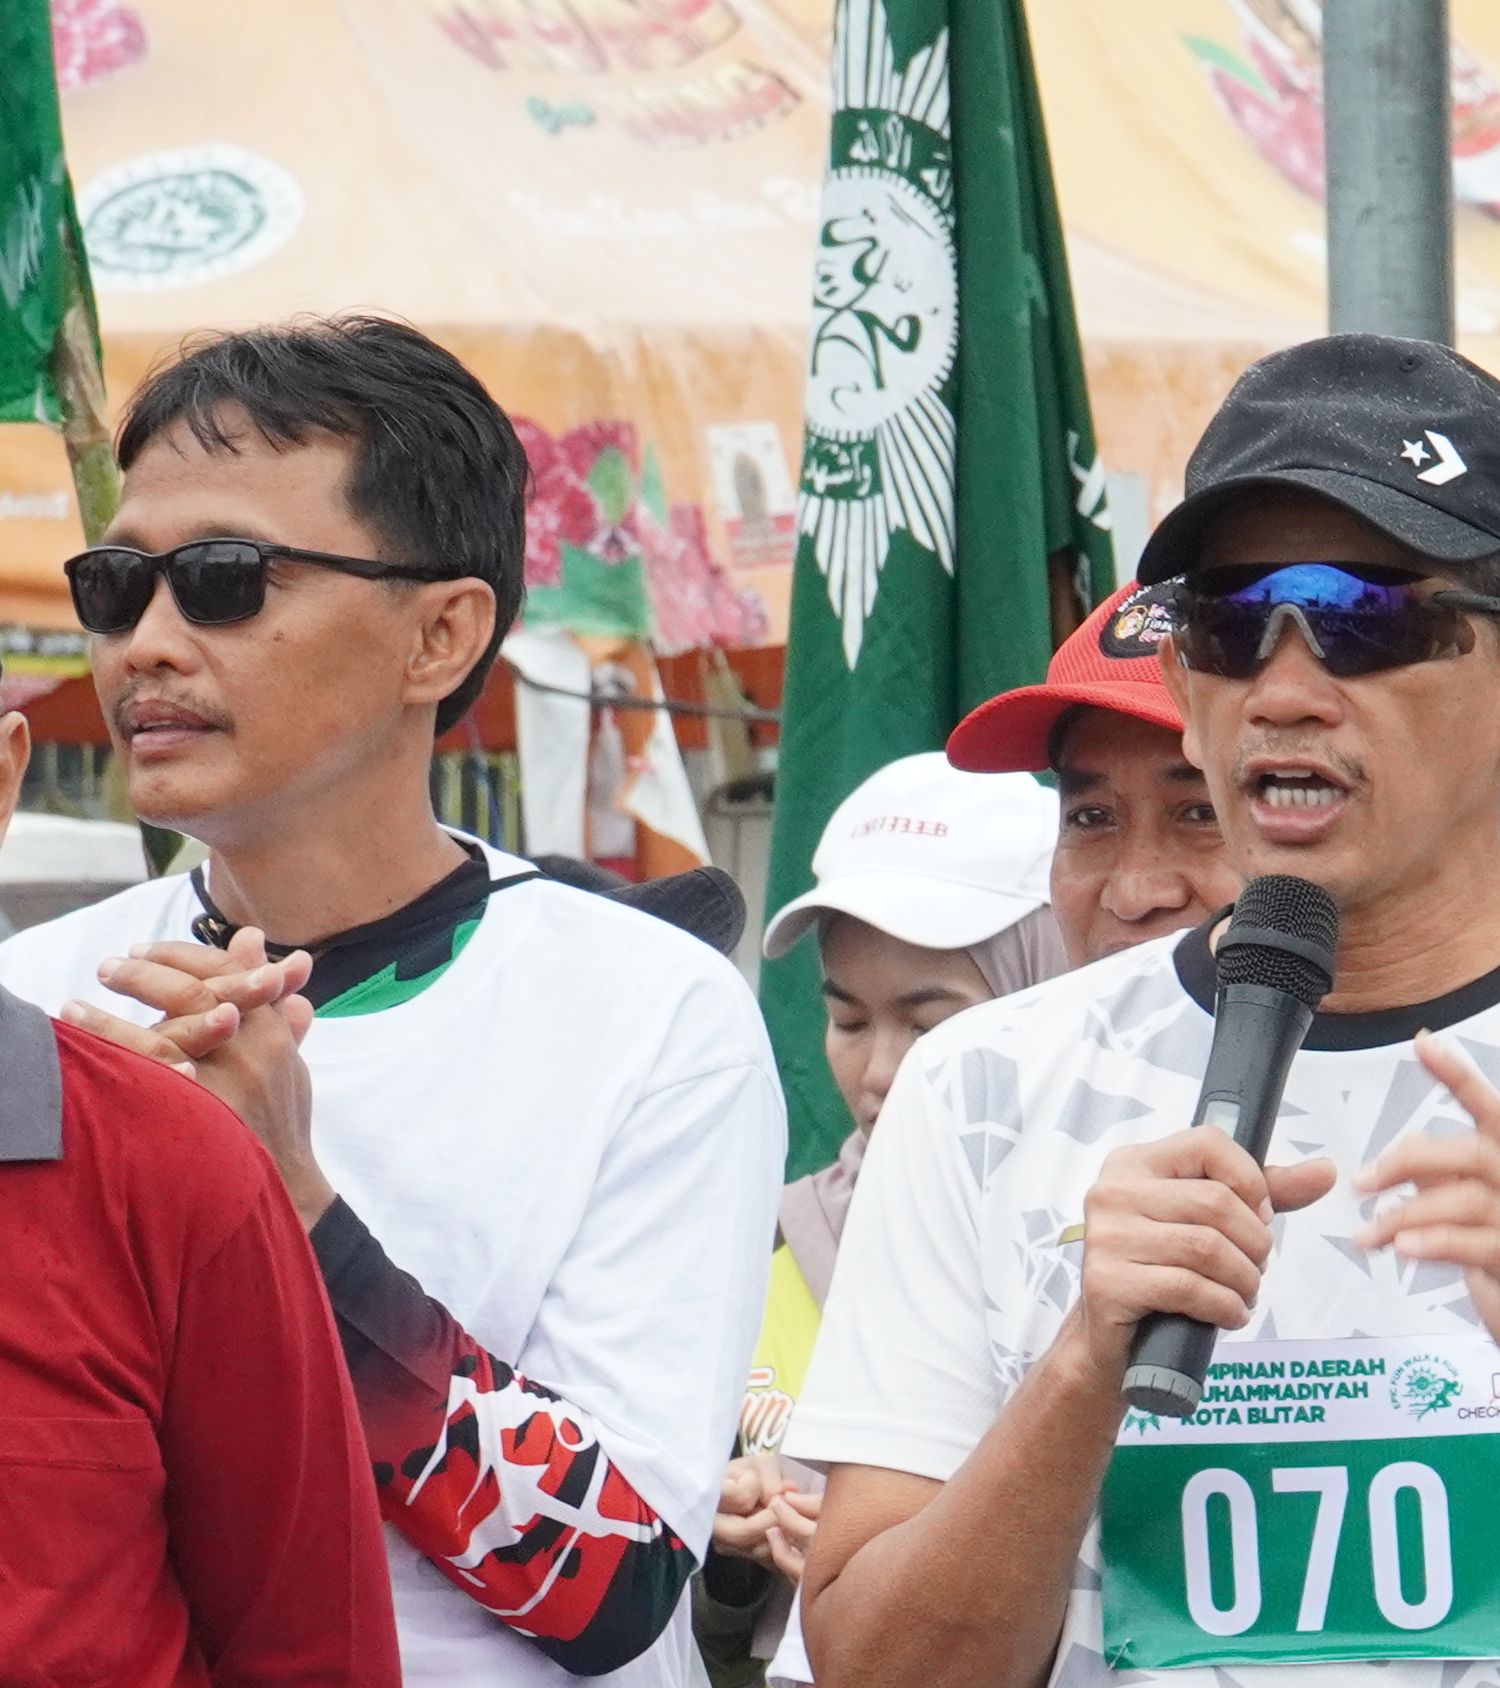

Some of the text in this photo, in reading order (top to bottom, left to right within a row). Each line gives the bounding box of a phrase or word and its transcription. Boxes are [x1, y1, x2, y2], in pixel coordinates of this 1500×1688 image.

[1205, 1358, 1386, 1380] MPINAN DAERAH
[1403, 1354, 1432, 1368] WALK
[1441, 1358, 1459, 1378] RUN
[1200, 1381, 1368, 1403] UHAMMADIYAH
[1181, 1405, 1326, 1426] KOTA BLITAR
[1180, 1460, 1455, 1638] 070
